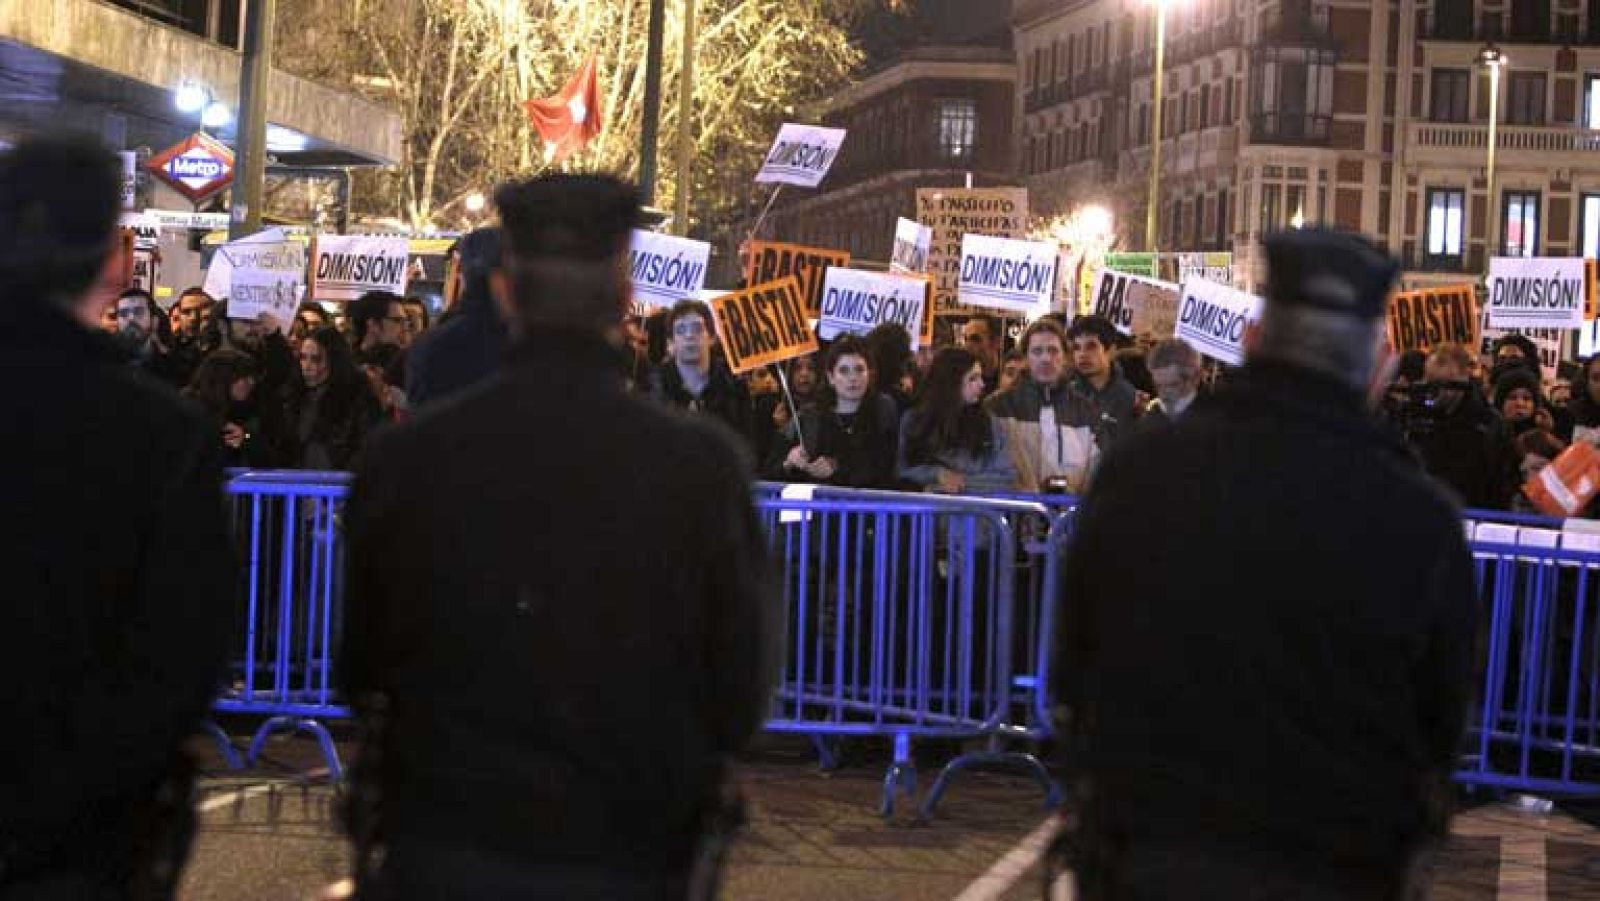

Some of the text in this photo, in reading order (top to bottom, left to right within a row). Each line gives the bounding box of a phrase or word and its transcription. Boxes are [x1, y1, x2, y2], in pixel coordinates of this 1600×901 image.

[173, 156, 221, 178] Metro
[316, 250, 405, 283] DIMISIÓN!
[630, 250, 703, 292] MISIÓN!
[961, 254, 1051, 294] DIMISIÓN!
[824, 287, 919, 329] DIMISIÓN!
[1493, 270, 1581, 310] DIMISIÓN!
[718, 282, 811, 369] ¡BASTA!
[1180, 295, 1247, 343] DIMISIÓ
[1391, 292, 1474, 352] ¡BASTA!
